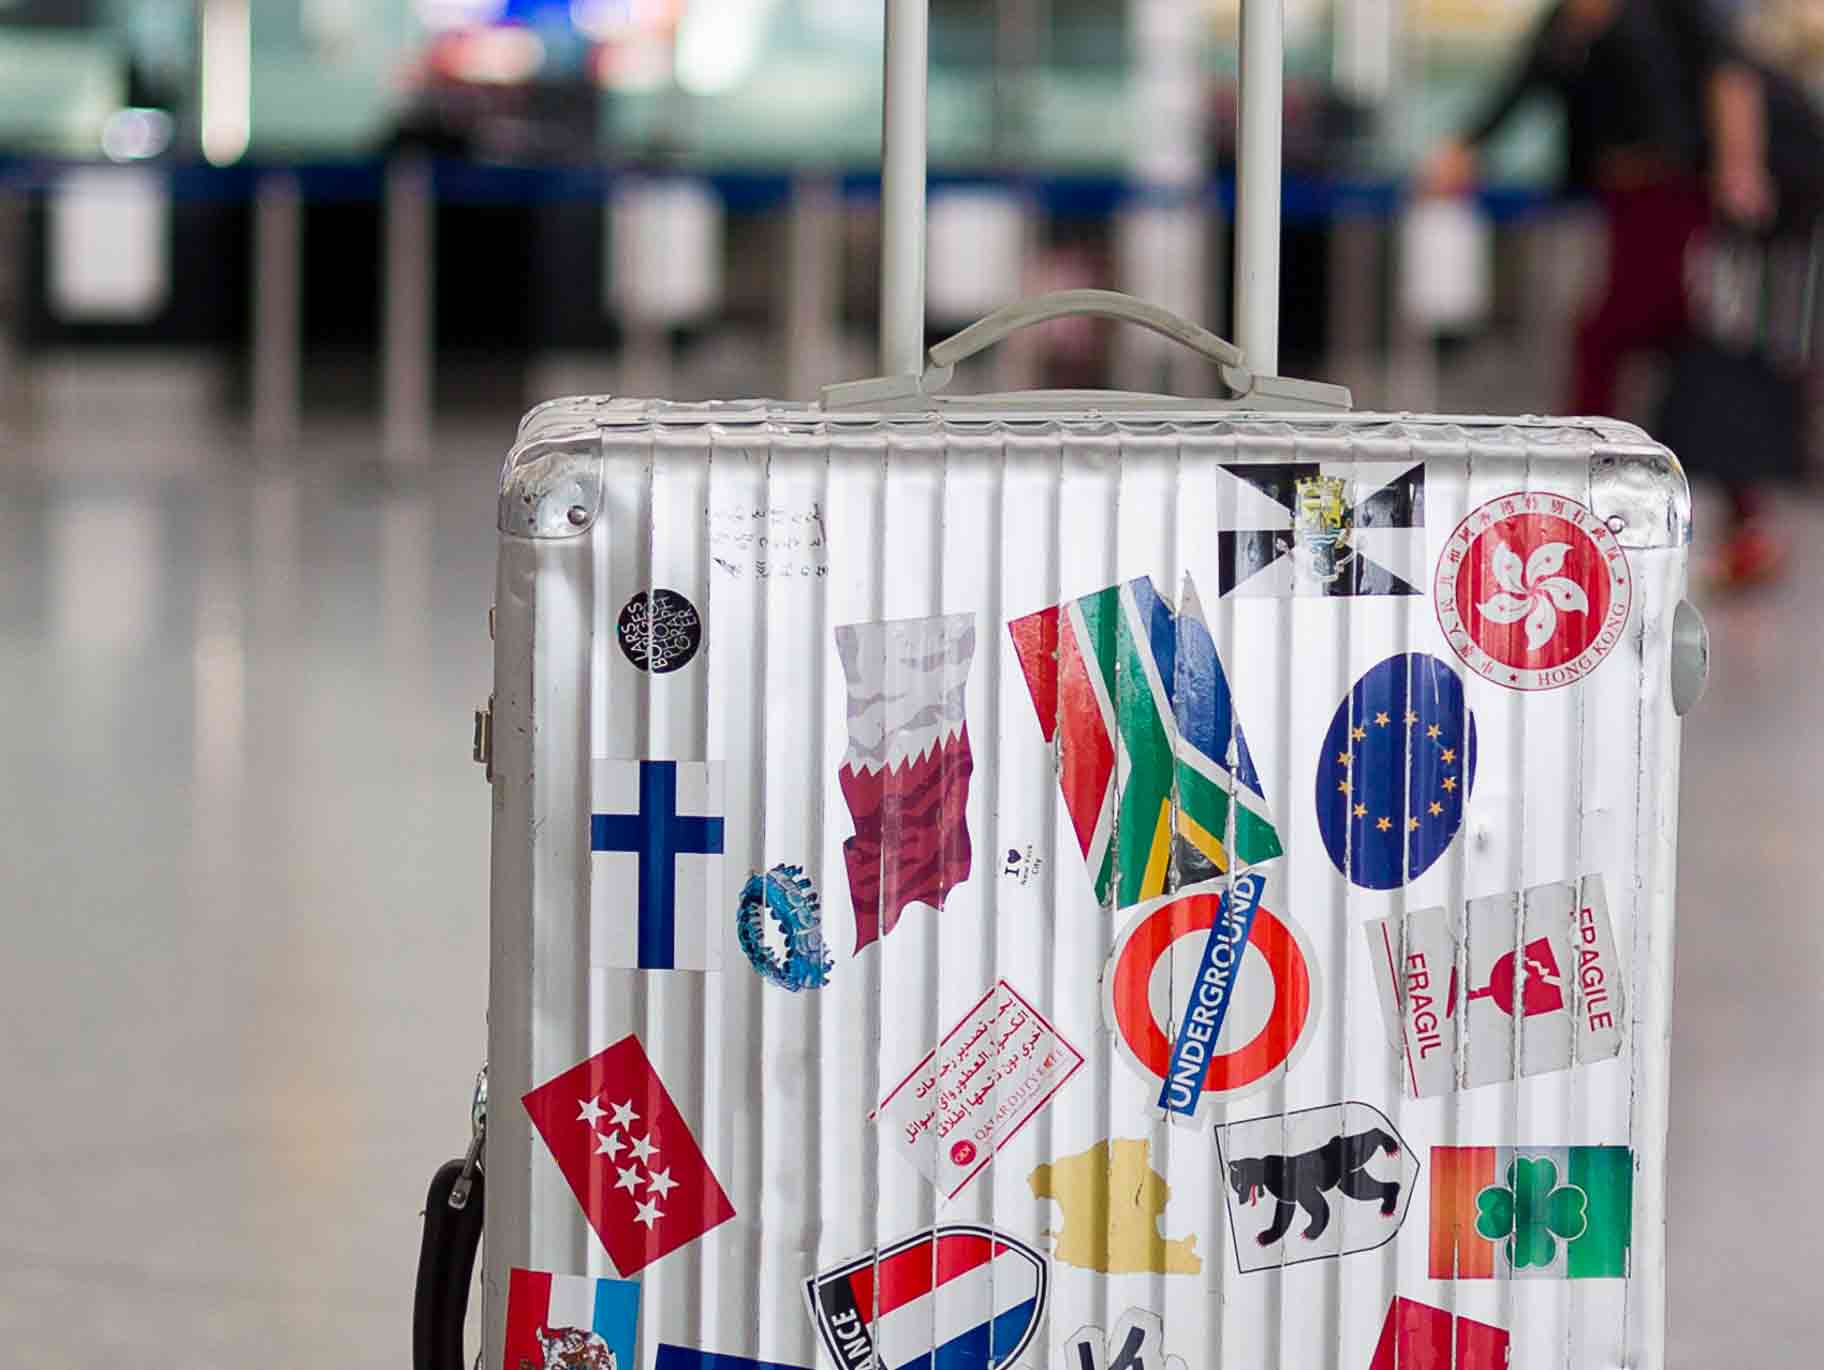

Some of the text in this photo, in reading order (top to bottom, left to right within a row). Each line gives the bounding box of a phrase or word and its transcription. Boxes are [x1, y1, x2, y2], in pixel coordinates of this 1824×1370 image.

[621, 622, 649, 661] LARS
[1537, 601, 1626, 686] HONG KONG
[1169, 876, 1256, 1108] UNDERGROUND
[1407, 952, 1441, 1059] FRAGIL
[1573, 907, 1613, 1031] FRAGILE
[831, 1309, 880, 1370] ANCE
